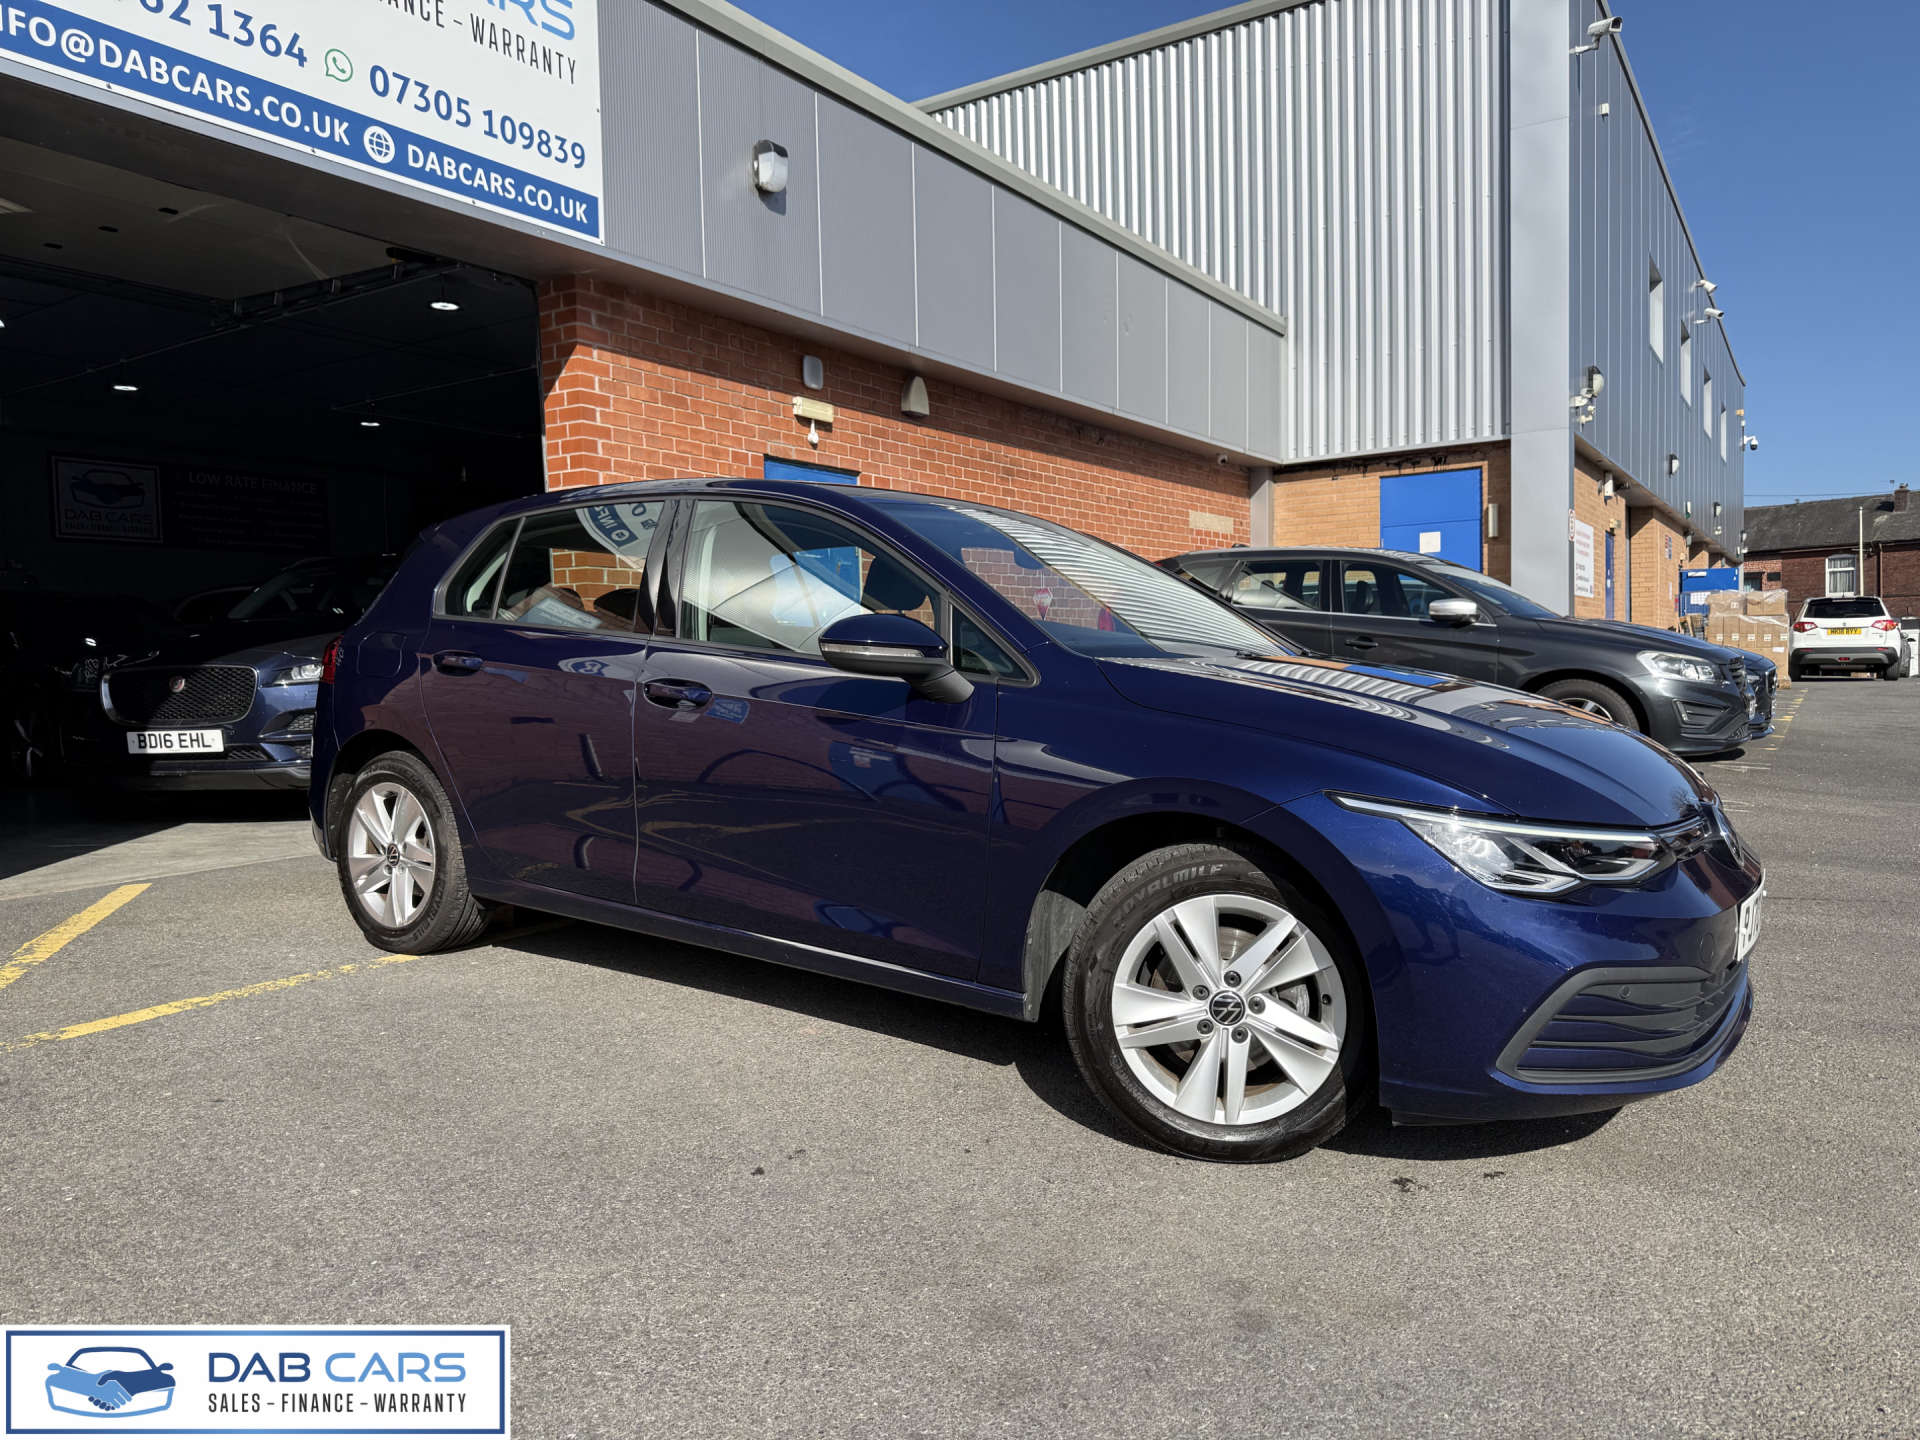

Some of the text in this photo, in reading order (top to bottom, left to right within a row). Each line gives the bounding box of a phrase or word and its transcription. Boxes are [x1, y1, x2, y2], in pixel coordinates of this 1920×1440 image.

[207, 3, 308, 68] 1364
[369, 64, 472, 128] 07305
[482, 109, 586, 169] 109839
[470, 12, 576, 85] WARRANTY
[0, 3, 588, 224] FO@DABCARS.CO.UK DABCARS.CO.UK
[136, 732, 212, 749] BD16 EHL
